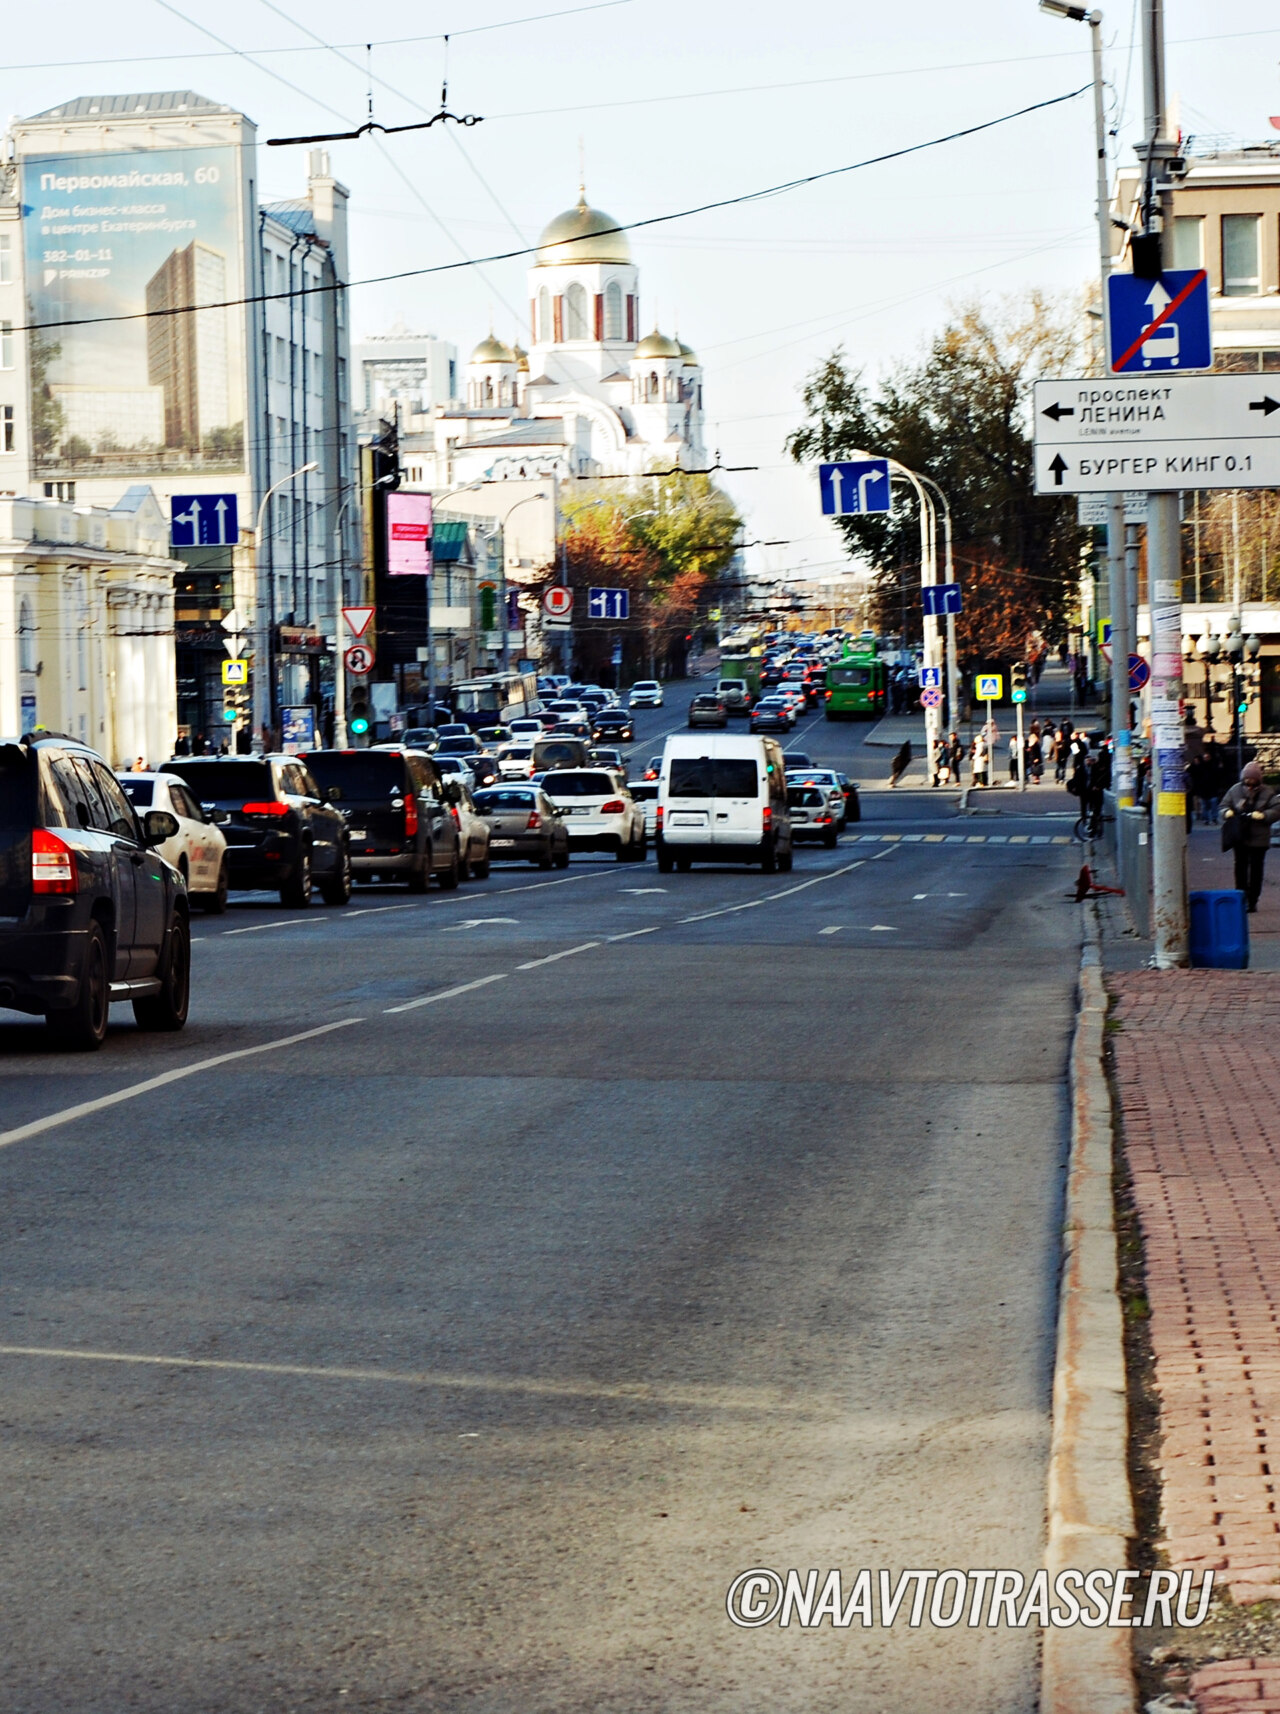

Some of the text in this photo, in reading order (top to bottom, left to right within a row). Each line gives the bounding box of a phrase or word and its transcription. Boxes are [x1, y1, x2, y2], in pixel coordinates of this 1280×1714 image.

[40, 166, 220, 193] Первомайская, 60
[40, 203, 166, 220] Дом бизнес-класса
[41, 217, 197, 236] в центре Екатеринбурга
[1078, 388, 1173, 406] проспект
[1079, 405, 1166, 423] ЛЕНИНА
[1080, 455, 1252, 475] БУРГЕР КИНГ 0.1
